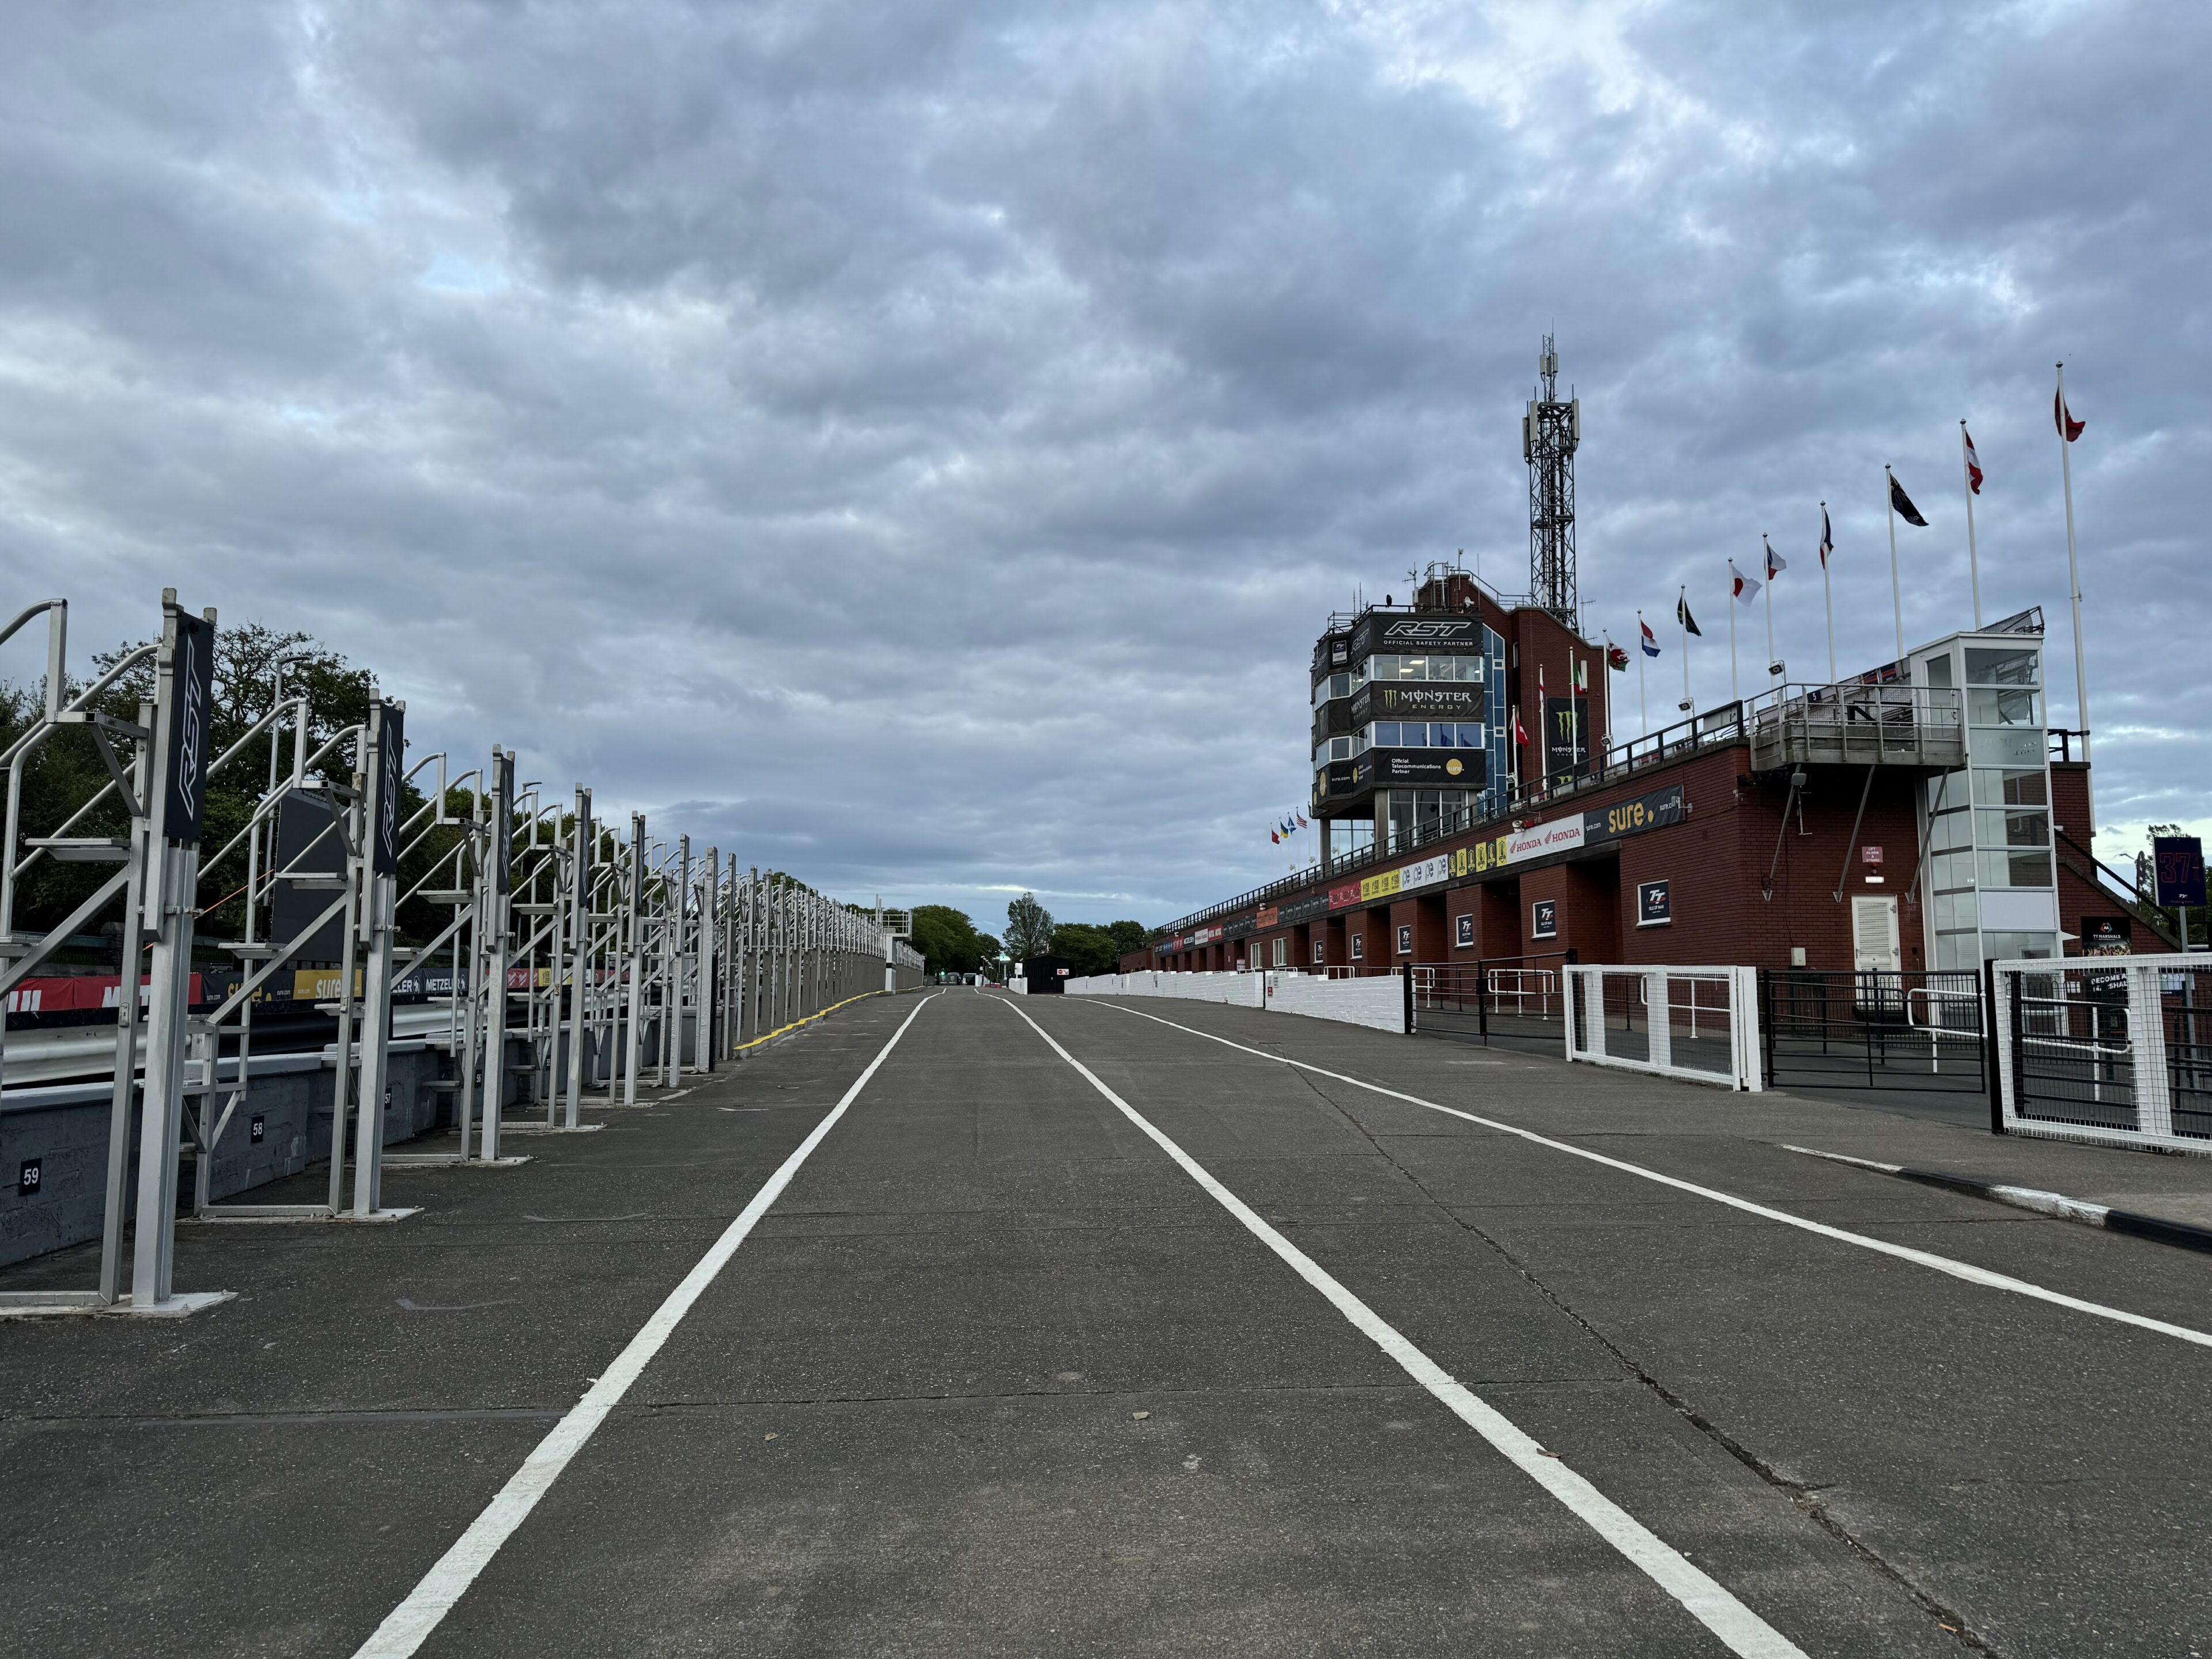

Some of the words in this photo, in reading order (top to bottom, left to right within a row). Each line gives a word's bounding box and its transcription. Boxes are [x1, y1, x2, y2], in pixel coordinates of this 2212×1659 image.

[1384, 621, 1472, 637] RST
[1812, 692, 1817, 701] 5
[179, 633, 201, 821] RST
[383, 719, 396, 858] RST
[1586, 822, 1601, 831] sure.com
[1517, 839, 1542, 852] HONDA
[1552, 828, 1580, 842] HONDA
[2159, 853, 2191, 883] 37
[1649, 889, 1666, 904] TT
[1541, 908, 1553, 921] TT
[1462, 921, 1471, 931] TT
[1403, 931, 1410, 940] TT
[384, 1093, 391, 1104] 57
[253, 1122, 263, 1136] 58
[24, 1167, 39, 1185] 59
